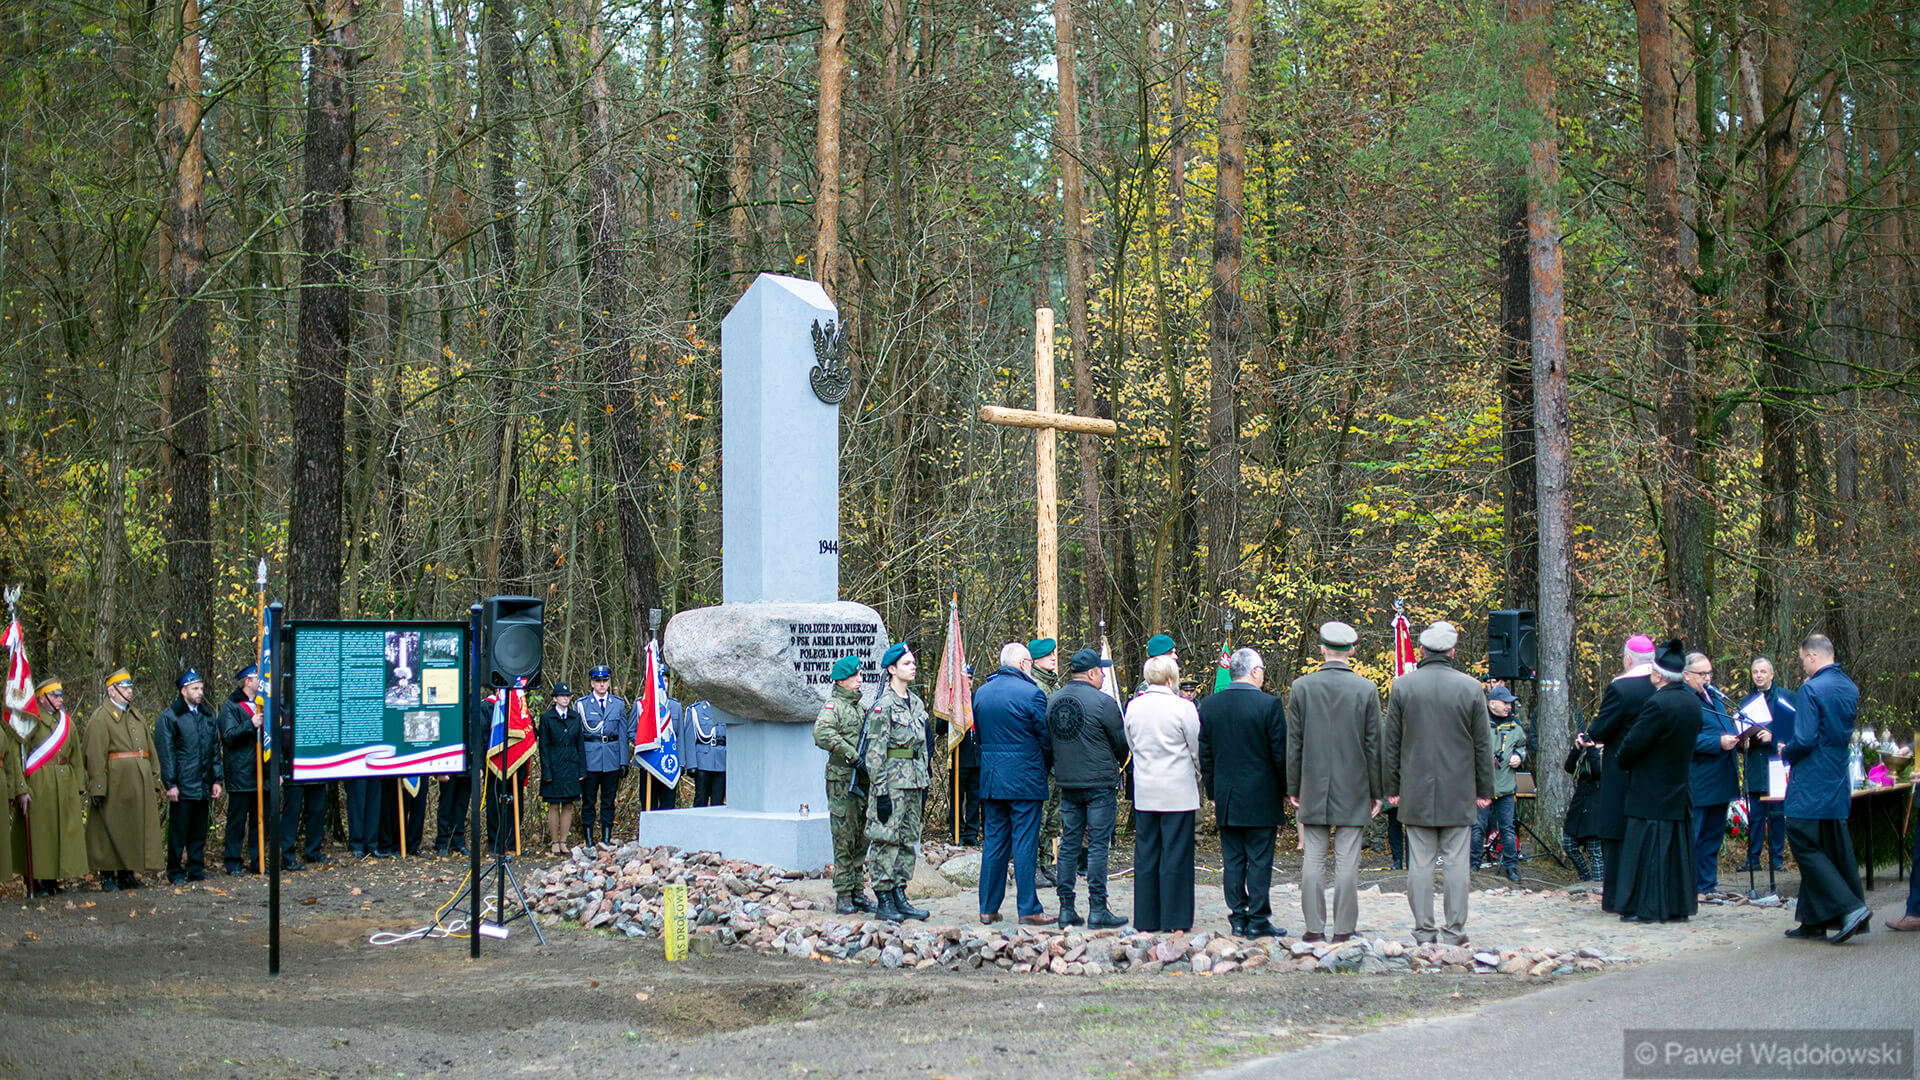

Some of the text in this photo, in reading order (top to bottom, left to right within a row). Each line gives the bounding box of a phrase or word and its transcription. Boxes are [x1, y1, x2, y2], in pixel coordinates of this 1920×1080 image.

[819, 540, 838, 554] 1944
[789, 623, 797, 633] W
[790, 635, 876, 646] 9 PSK ARMII KRAJOWEJ
[800, 648, 839, 659] POLEGŁYM
[840, 648, 845, 658] 8
[856, 648, 871, 658] 1944
[793, 661, 801, 671] W
[803, 661, 831, 671] BITWIE
[806, 674, 818, 684] NA
